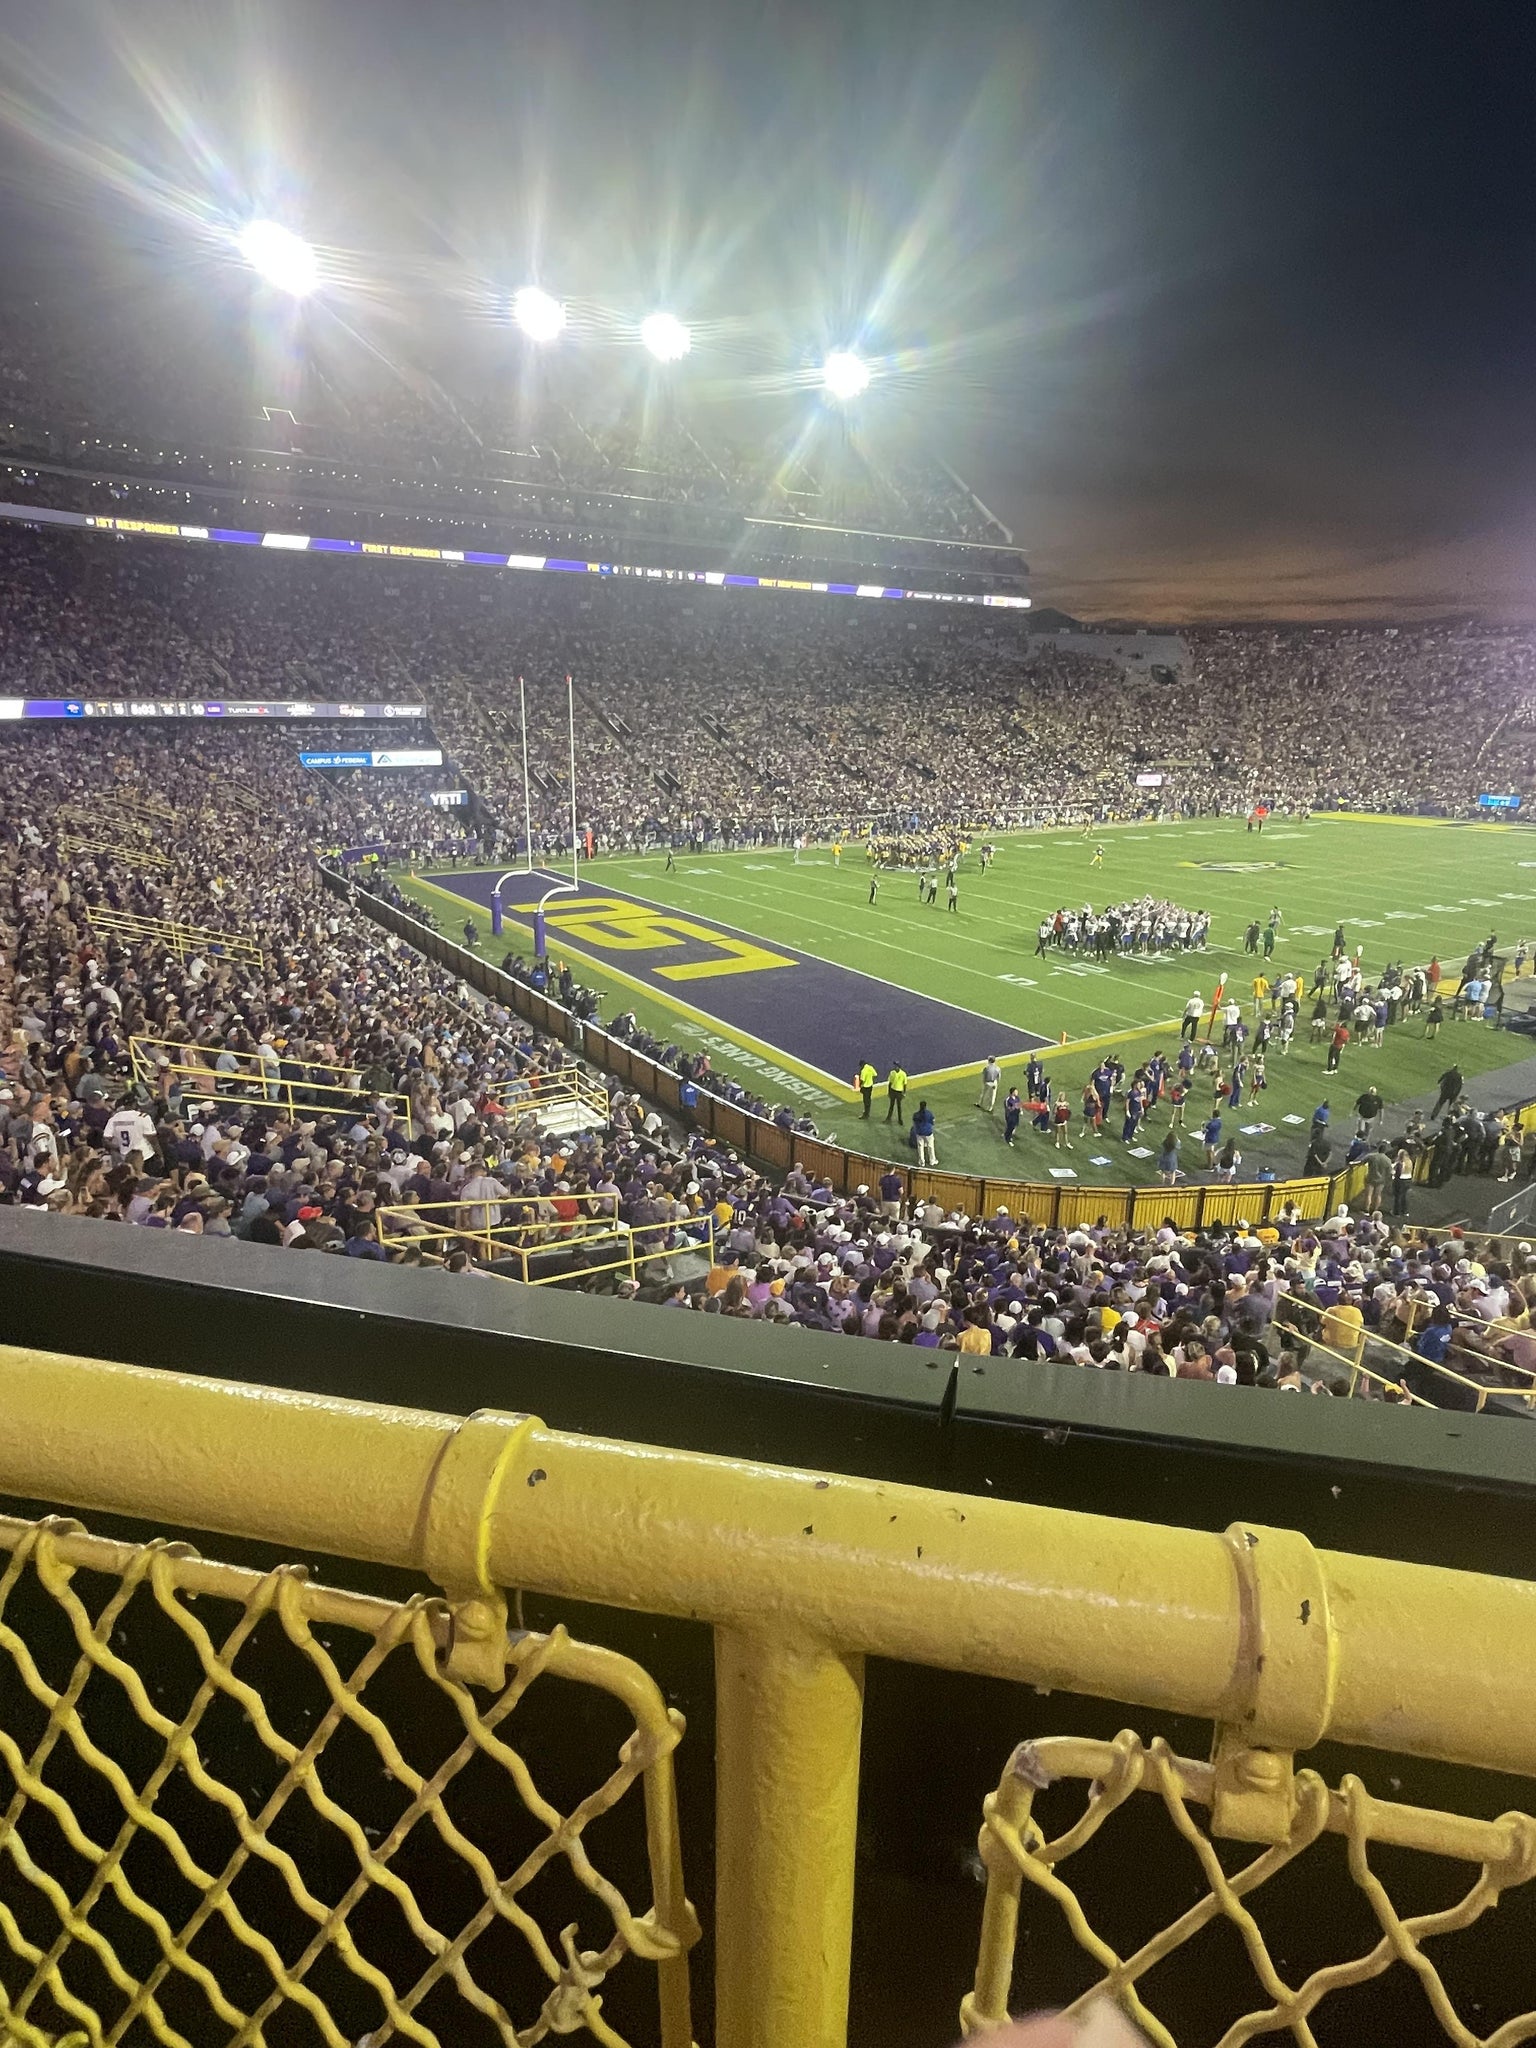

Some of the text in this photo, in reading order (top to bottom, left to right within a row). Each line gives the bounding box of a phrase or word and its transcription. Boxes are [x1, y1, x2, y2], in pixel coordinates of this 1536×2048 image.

[306, 757, 332, 765] CAMPUS
[430, 793, 462, 806] YETI
[508, 898, 801, 981] LSU
[120, 1130, 130, 1148] 9
